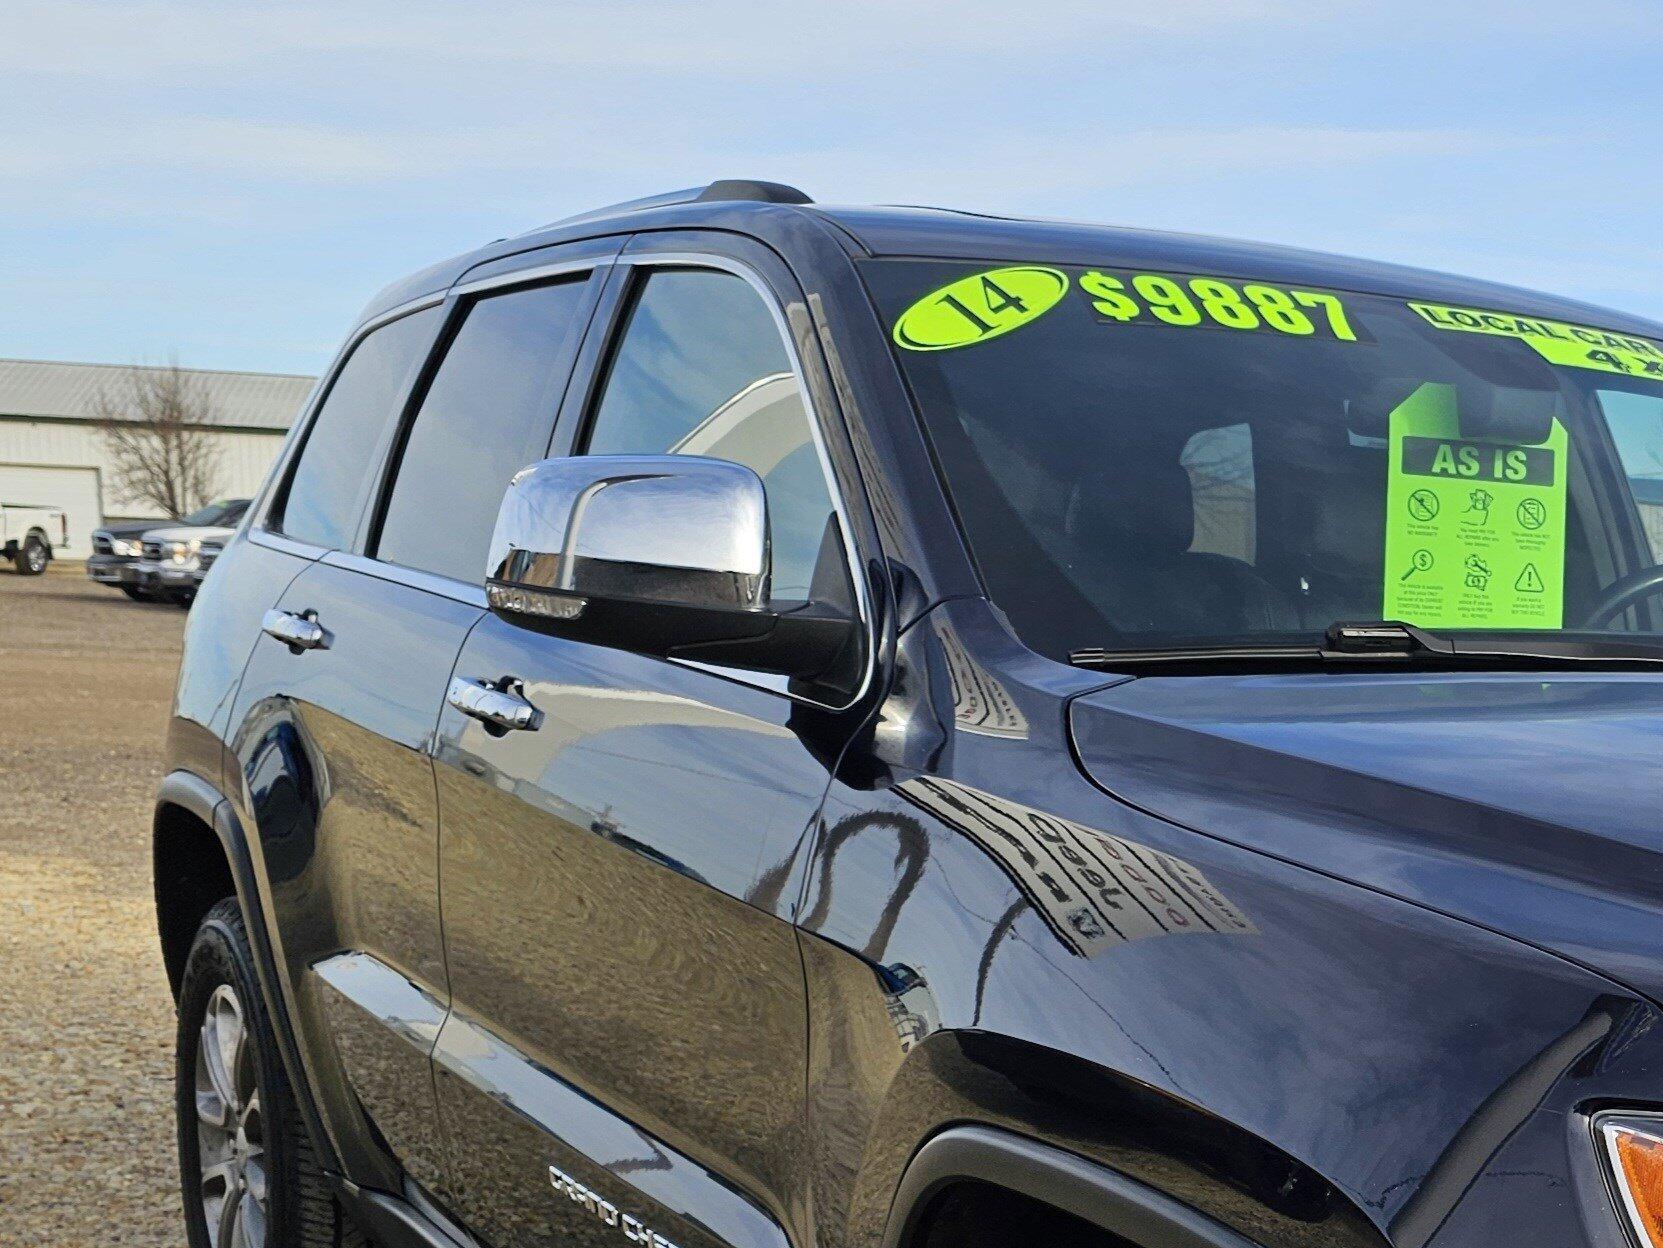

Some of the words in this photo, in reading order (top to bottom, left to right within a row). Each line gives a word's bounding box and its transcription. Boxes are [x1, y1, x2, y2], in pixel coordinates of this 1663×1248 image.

[935, 275, 1030, 337] 14
[1078, 271, 1357, 342] $9887
[1420, 306, 1568, 343] LOCAL
[1569, 328, 1663, 359] CAR
[1431, 444, 1479, 477] AS
[1492, 447, 1528, 480] IS
[548, 1164, 619, 1228] GRAND
